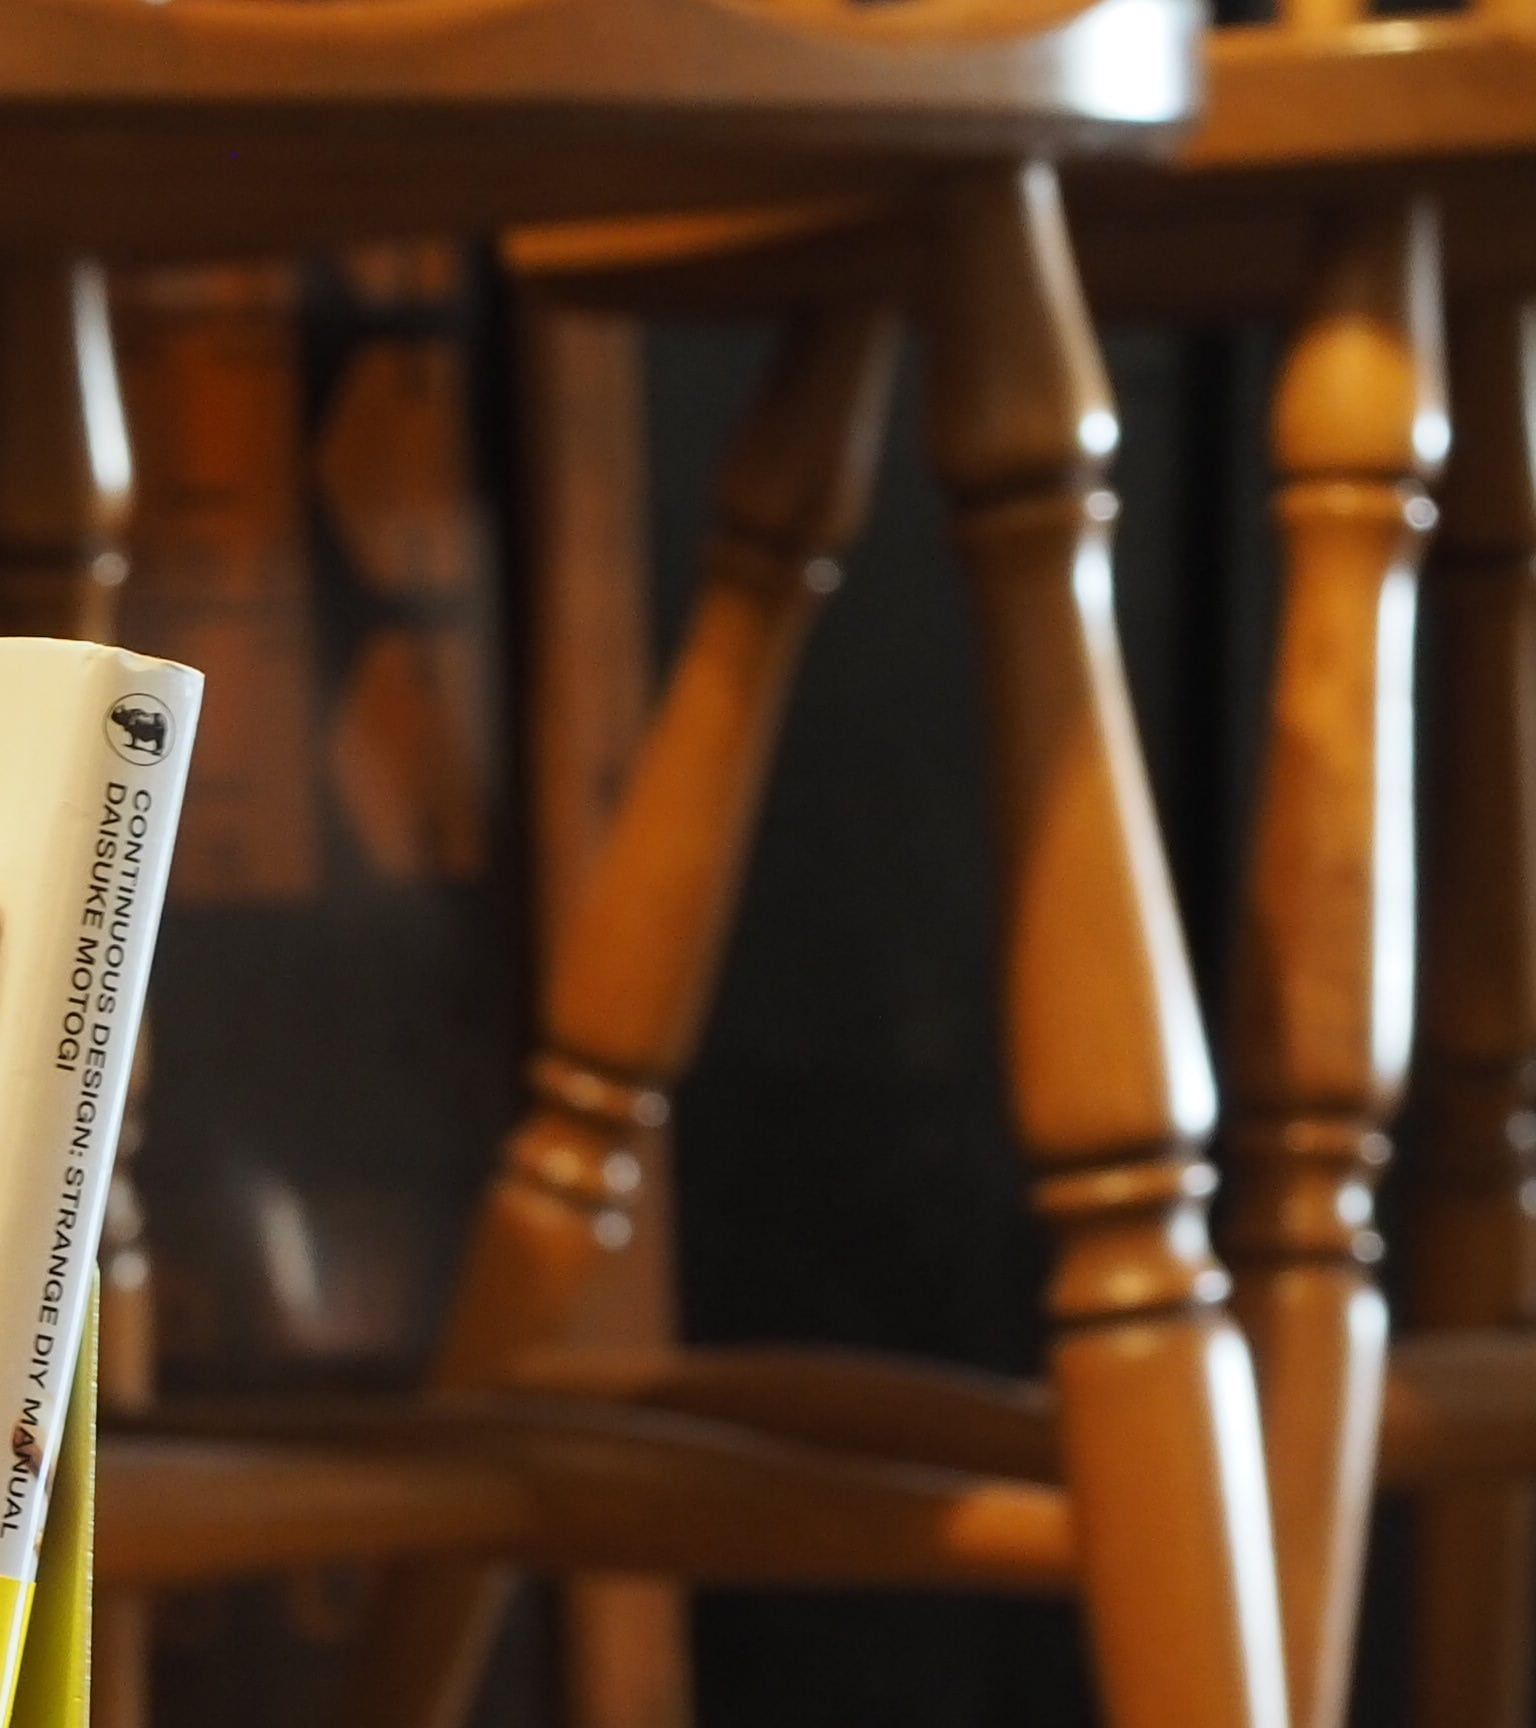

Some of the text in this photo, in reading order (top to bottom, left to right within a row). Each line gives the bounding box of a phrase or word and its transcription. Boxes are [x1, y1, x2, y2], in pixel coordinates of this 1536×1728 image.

[55, 782, 128, 1072] DAISUKE MOTOGI
[98, 788, 153, 1016] CONTINUOUS
[67, 1023, 111, 1157] DESIGN:
[33, 1165, 86, 1327] STRANGE
[26, 1333, 55, 1392] DIY
